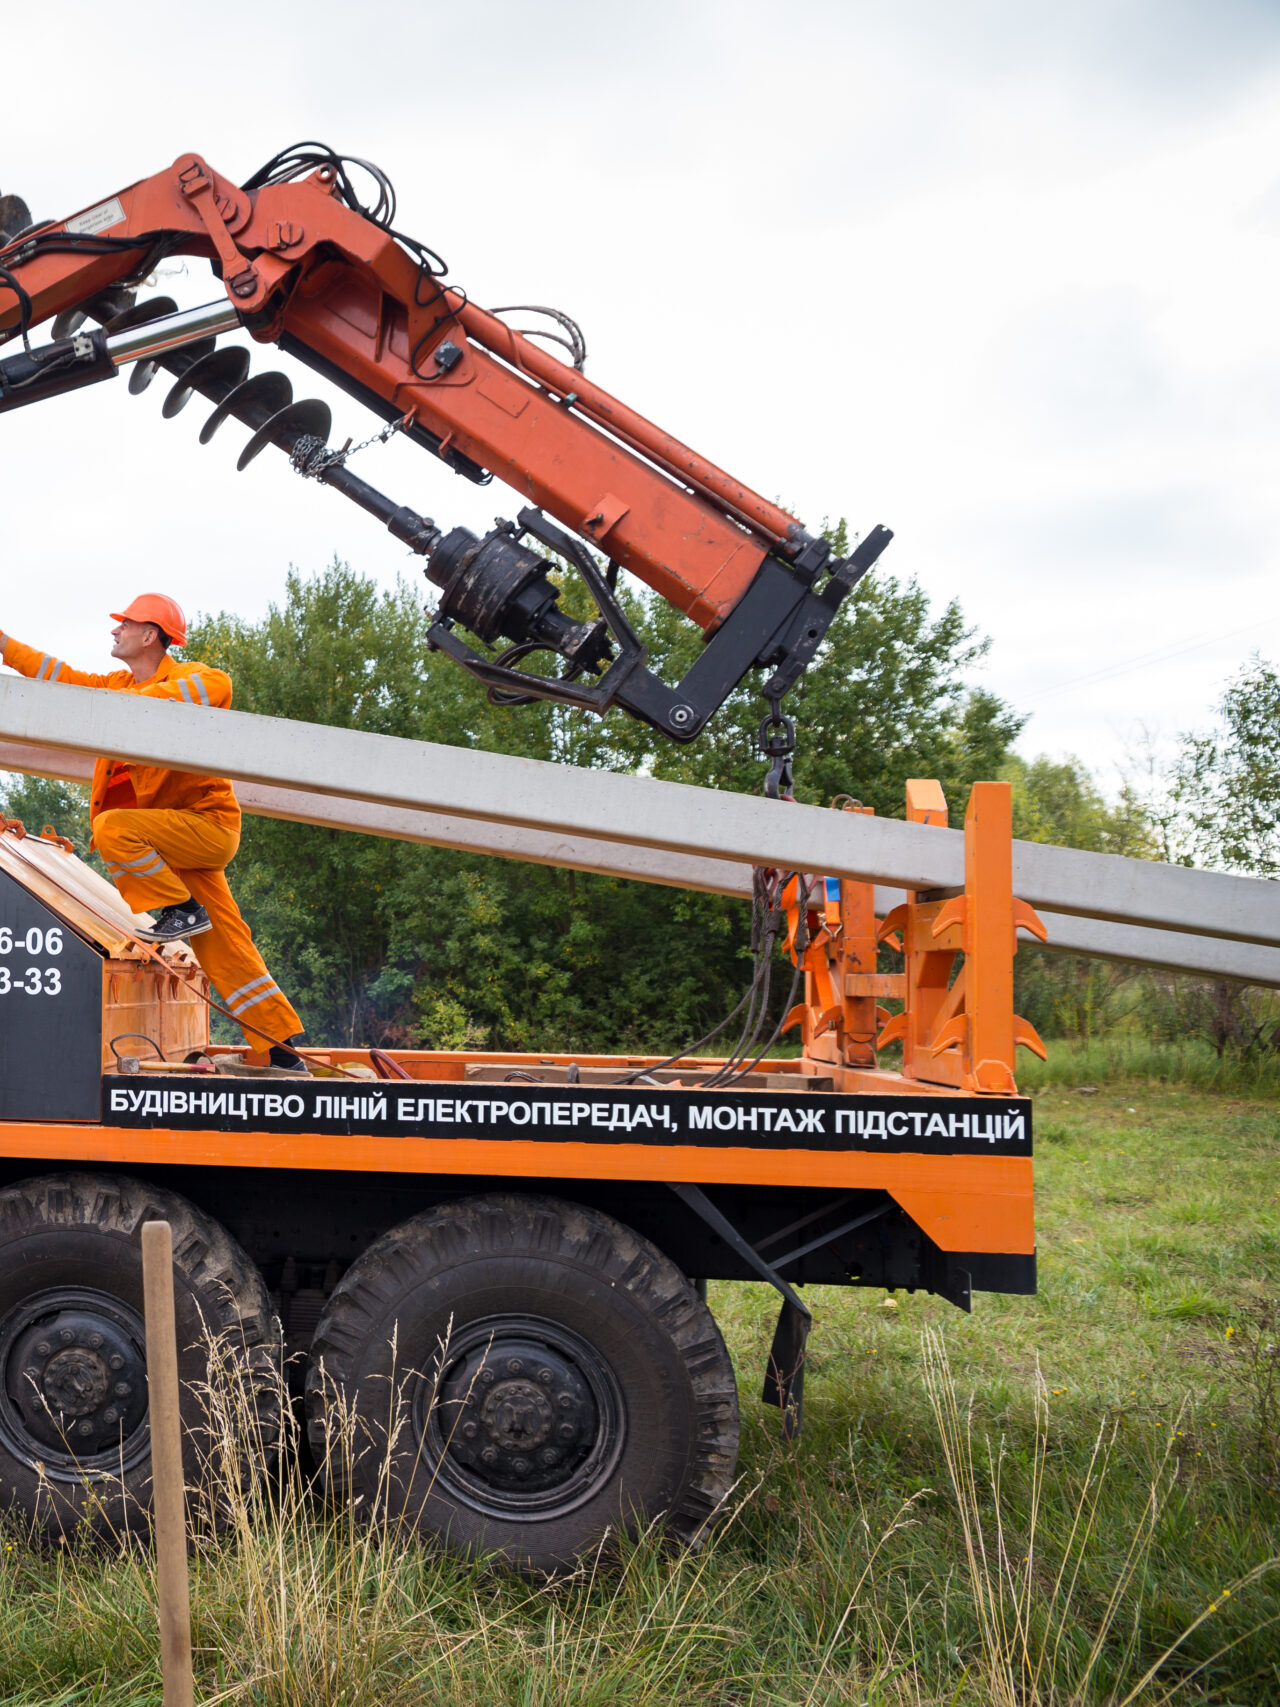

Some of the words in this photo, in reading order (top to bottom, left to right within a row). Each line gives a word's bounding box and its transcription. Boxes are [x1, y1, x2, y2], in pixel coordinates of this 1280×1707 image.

[110, 1088, 305, 1120] БУДІВНИЦТВО
[313, 1090, 387, 1121] ЛІНІЙ
[397, 1098, 677, 1133] ЕЛЕКТРОПЕРЕДАЧ,
[688, 1105, 825, 1134] МОНТАЖ
[835, 1108, 1026, 1144] ПІДСТАНЦІЙ
